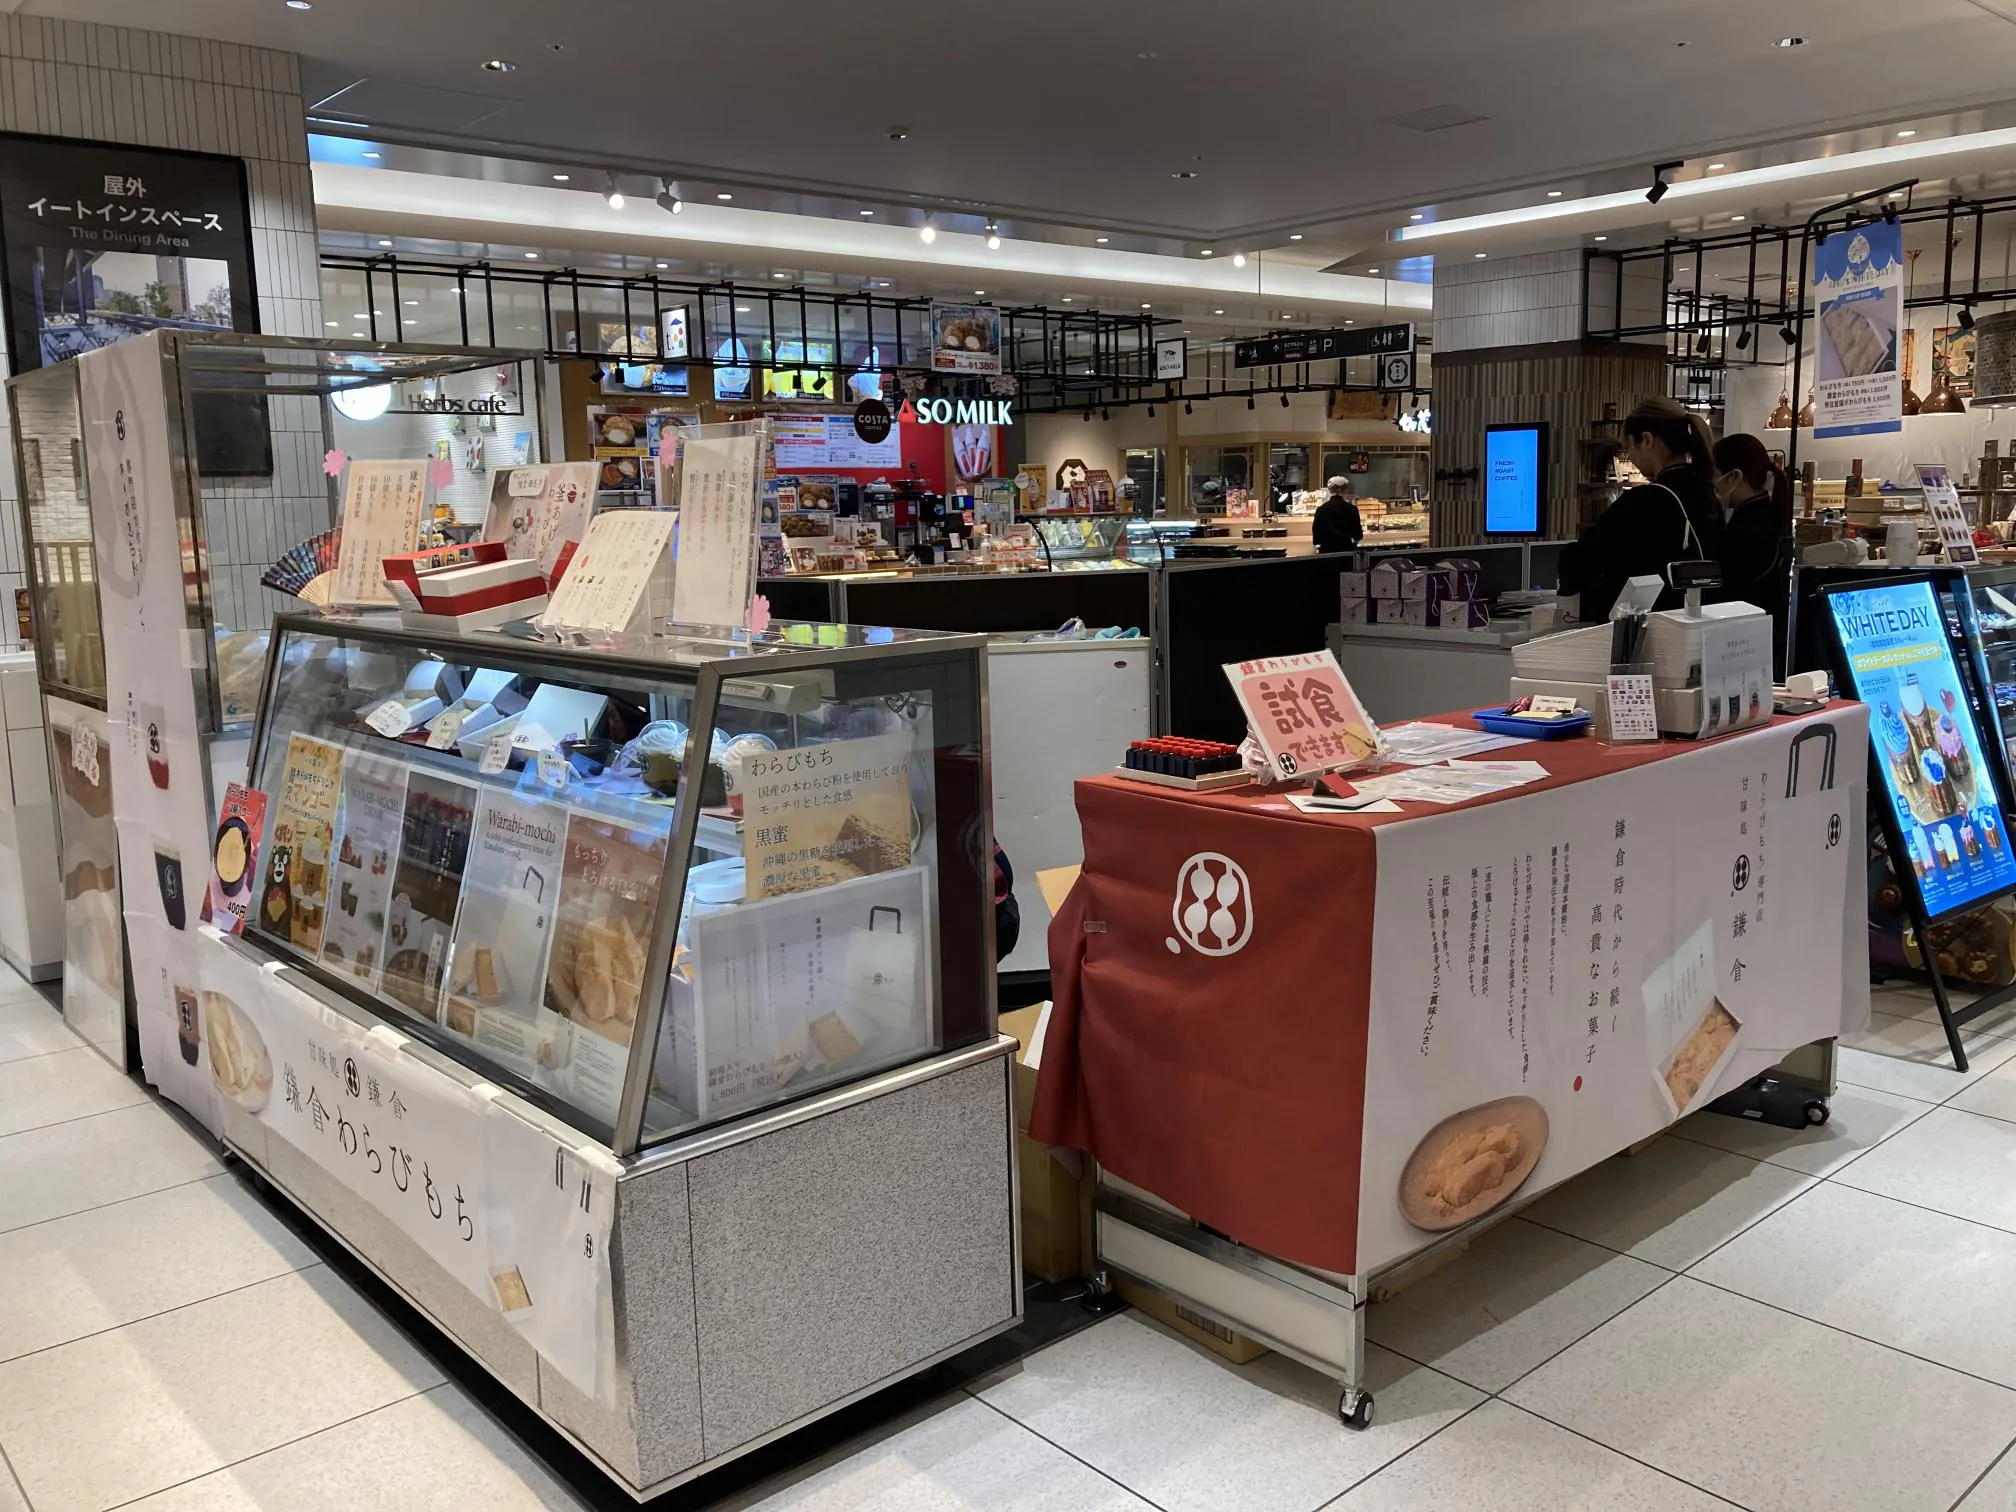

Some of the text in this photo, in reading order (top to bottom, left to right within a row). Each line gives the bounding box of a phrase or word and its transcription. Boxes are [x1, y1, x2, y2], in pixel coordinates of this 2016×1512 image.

[104, 175, 147, 198] 屋外
[28, 197, 223, 232] イートインスペース
[70, 226, 190, 248] The Dining Area
[410, 393, 507, 412] Herbs cafe
[956, 400, 1013, 425] MILK
[858, 415, 889, 424] COSTA
[1840, 606, 1930, 639] WHITE DAY
[1240, 654, 1323, 675] 鎌倉わらびもち
[1259, 677, 1345, 735] 試食
[1288, 731, 1346, 762] できます
[751, 749, 833, 777] わらびもち
[758, 763, 907, 799] 国産の本わらび粉を使用しており
[293, 783, 330, 810] マンゴー
[760, 789, 853, 815] モッチリとした食感
[489, 808, 556, 844] Warabi-mochi
[755, 825, 789, 849] 黒蜜
[1756, 772, 1768, 923] わらびもち専門店
[763, 865, 822, 888] 濃厚な黒蜜
[227, 901, 247, 919] 400円
[1609, 819, 1626, 1032] 鎌倉時代から続く
[1730, 912, 1747, 982] 鎌倉
[1585, 904, 1602, 1063] 高貴なお菓子
[307, 1038, 407, 1120] 甘味処 鎌倉
[284, 1062, 474, 1241] 鎌倉わらびもち
